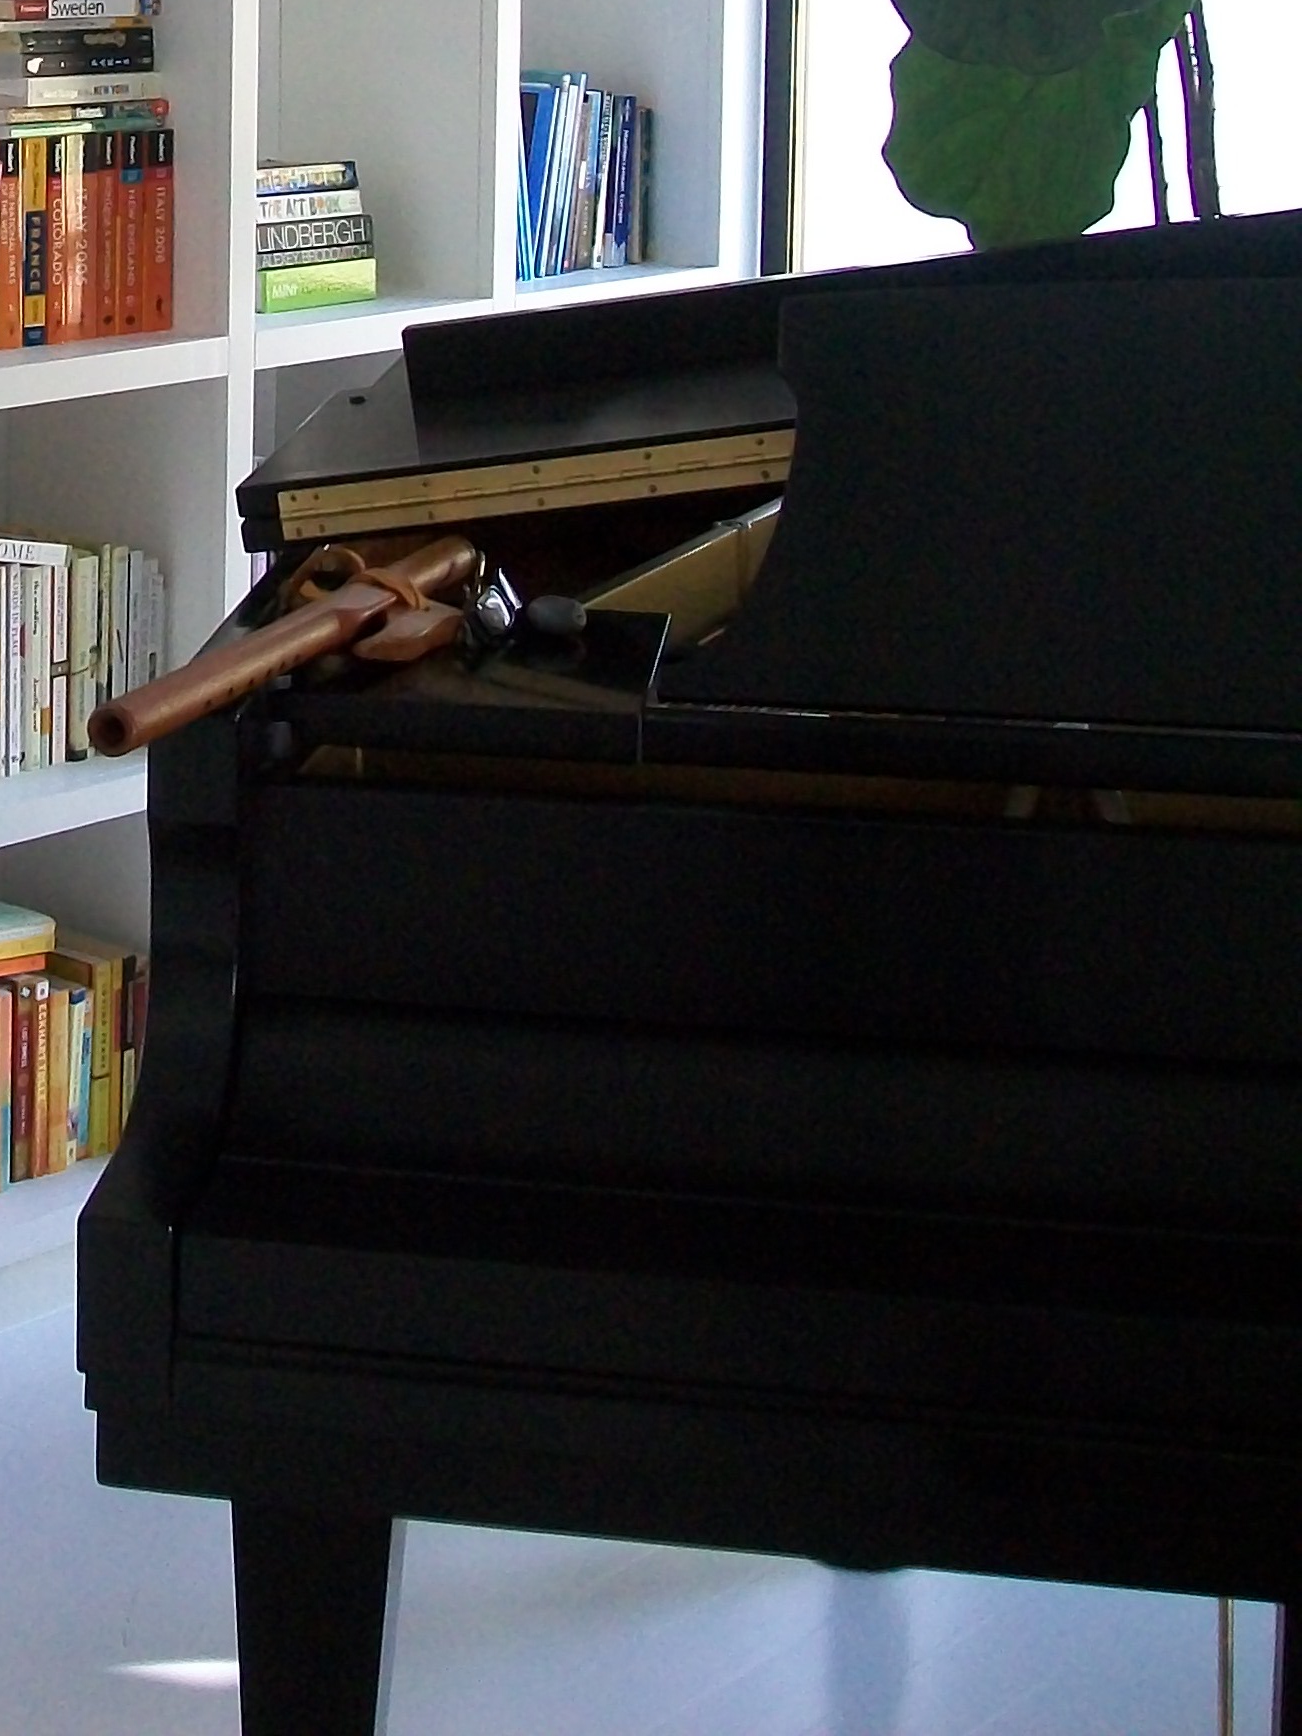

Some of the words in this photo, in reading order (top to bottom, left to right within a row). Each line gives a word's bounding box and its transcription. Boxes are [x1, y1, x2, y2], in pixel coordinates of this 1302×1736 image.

[50, 0, 105, 17] Sweden
[154, 186, 167, 223] ITALY
[1, 220, 9, 246] WEST
[8, 203, 17, 253] NATIONAL
[51, 198, 63, 287] COLORADO
[257, 218, 366, 252] LINDBERGH
[8, 254, 17, 285] PARKS
[28, 215, 42, 292] FRANCE
[126, 223, 137, 287] ENGLAND
[11, 612, 20, 624] IN
[10, 626, 20, 658] PLACE
[36, 1004, 48, 1062] ECKHART
[37, 1064, 48, 1102] TOLLE
